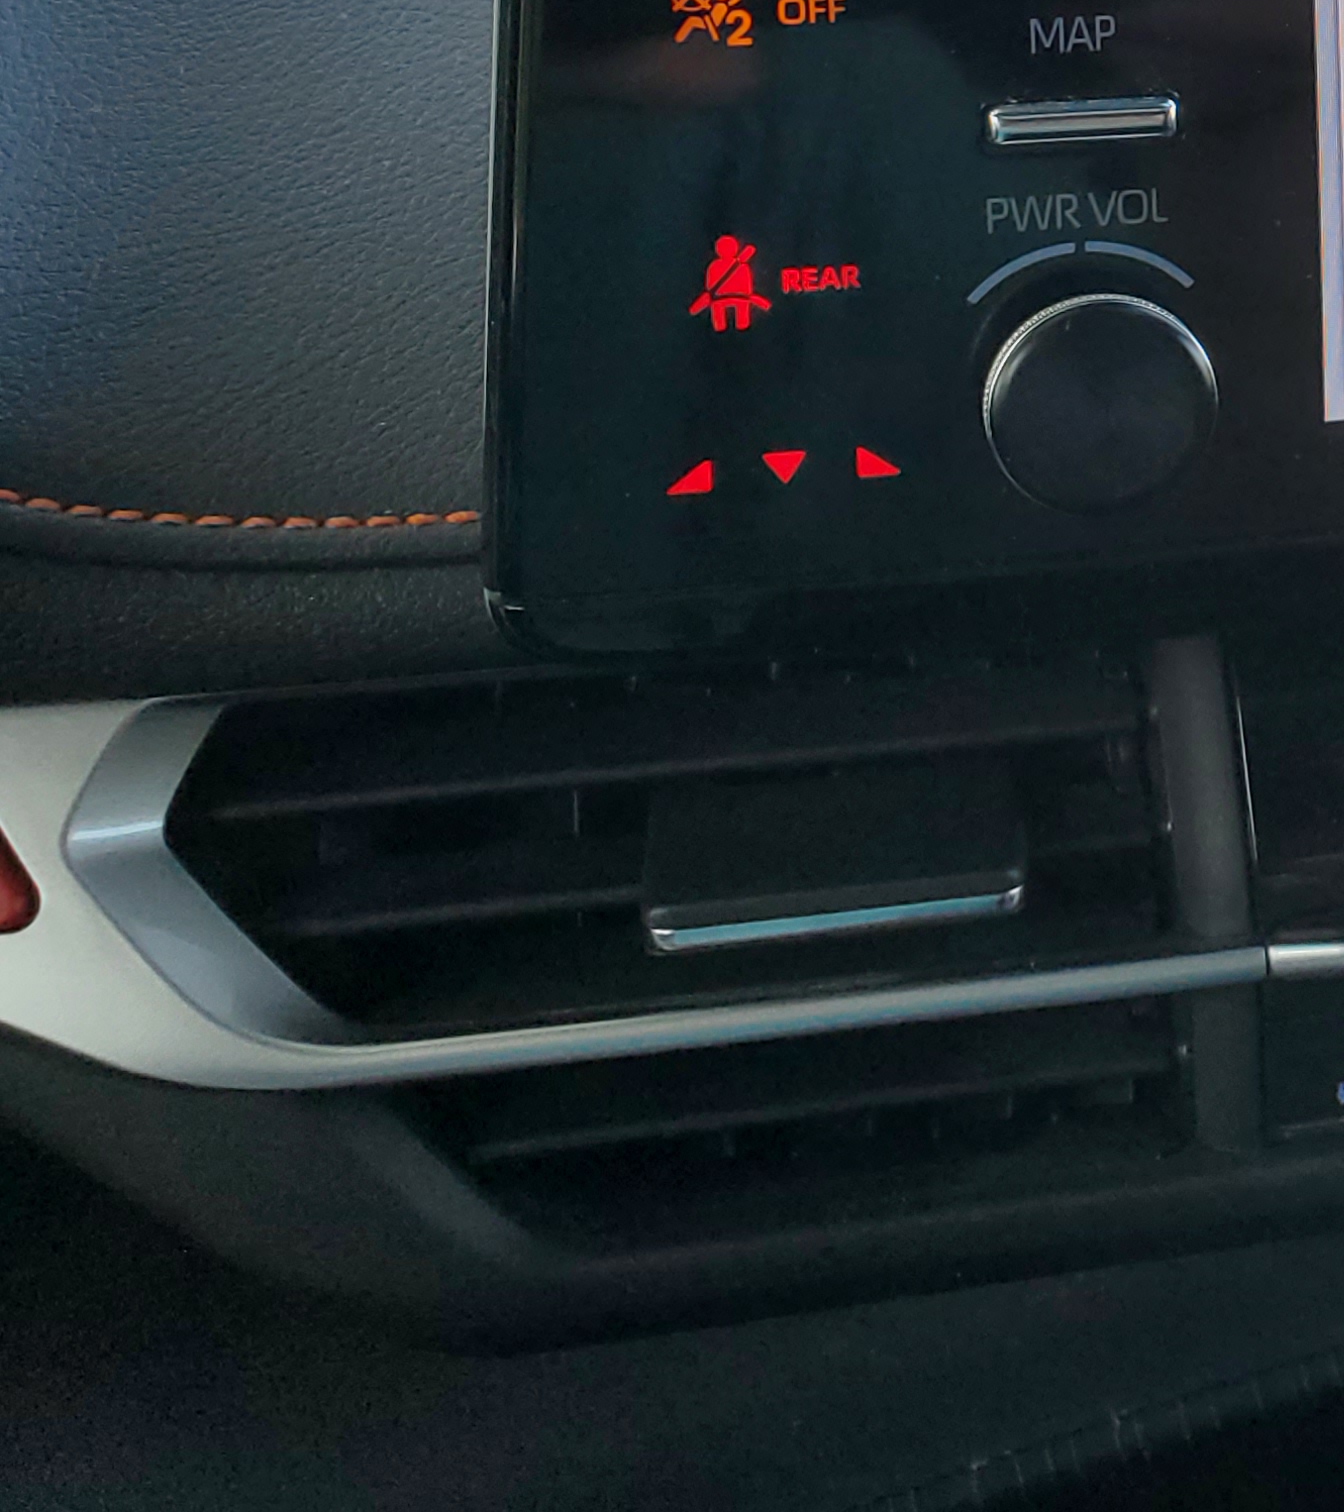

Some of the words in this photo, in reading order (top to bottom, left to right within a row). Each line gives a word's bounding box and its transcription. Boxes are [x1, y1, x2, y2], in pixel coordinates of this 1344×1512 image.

[1030, 15, 1116, 55] MAP
[985, 193, 1081, 234] PWR
[1085, 187, 1169, 226] VOL
[780, 264, 861, 294] REAR
